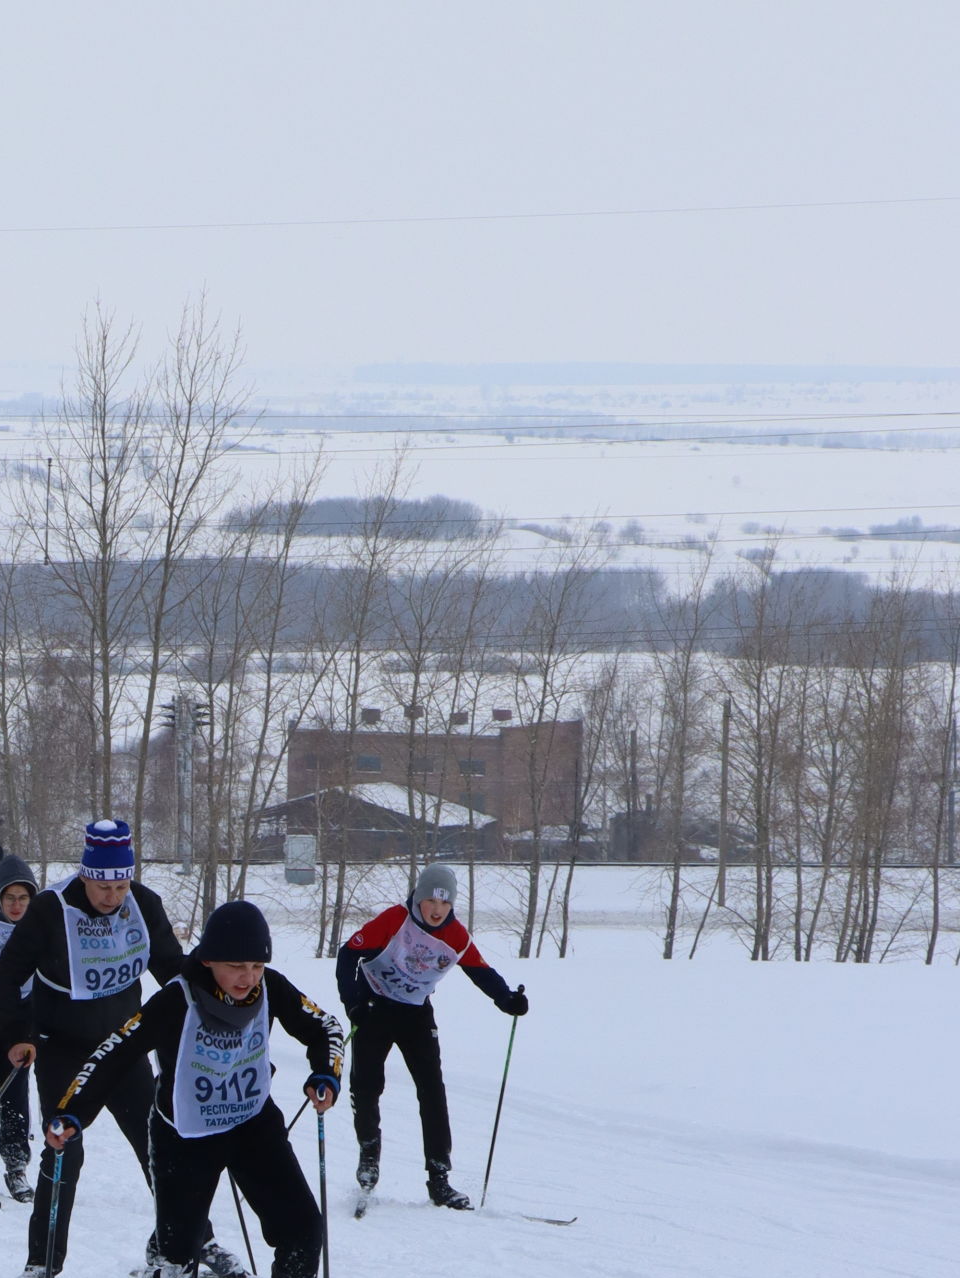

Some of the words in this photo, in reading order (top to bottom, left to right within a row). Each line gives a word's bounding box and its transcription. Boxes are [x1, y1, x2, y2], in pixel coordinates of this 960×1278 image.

[432, 887, 450, 900] NEW
[77, 926, 113, 937] РОССИИ
[80, 937, 117, 950] 2021
[85, 957, 143, 992] 9280
[195, 1031, 243, 1051] РОССИИ
[194, 1066, 262, 1103] 9112
